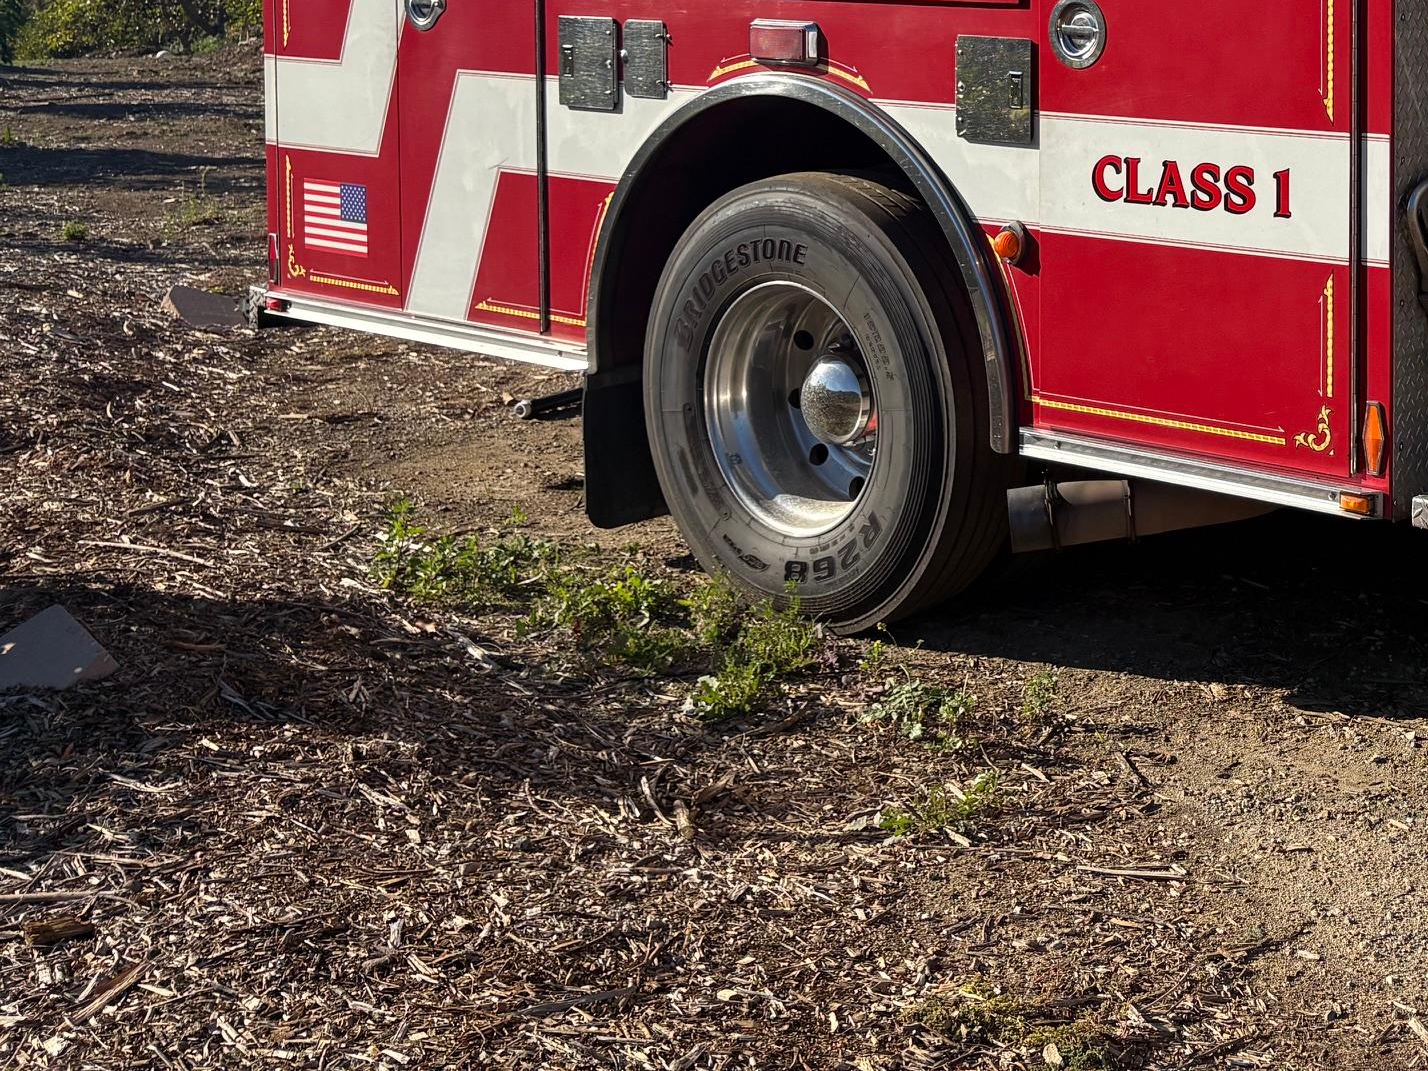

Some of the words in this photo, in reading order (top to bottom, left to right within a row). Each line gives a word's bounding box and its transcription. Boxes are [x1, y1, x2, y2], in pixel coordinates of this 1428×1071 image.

[1092, 154, 1257, 215] CLASS
[1273, 168, 1292, 219] 1
[673, 237, 809, 353] BRIDGESTONE
[784, 510, 883, 584] R268
